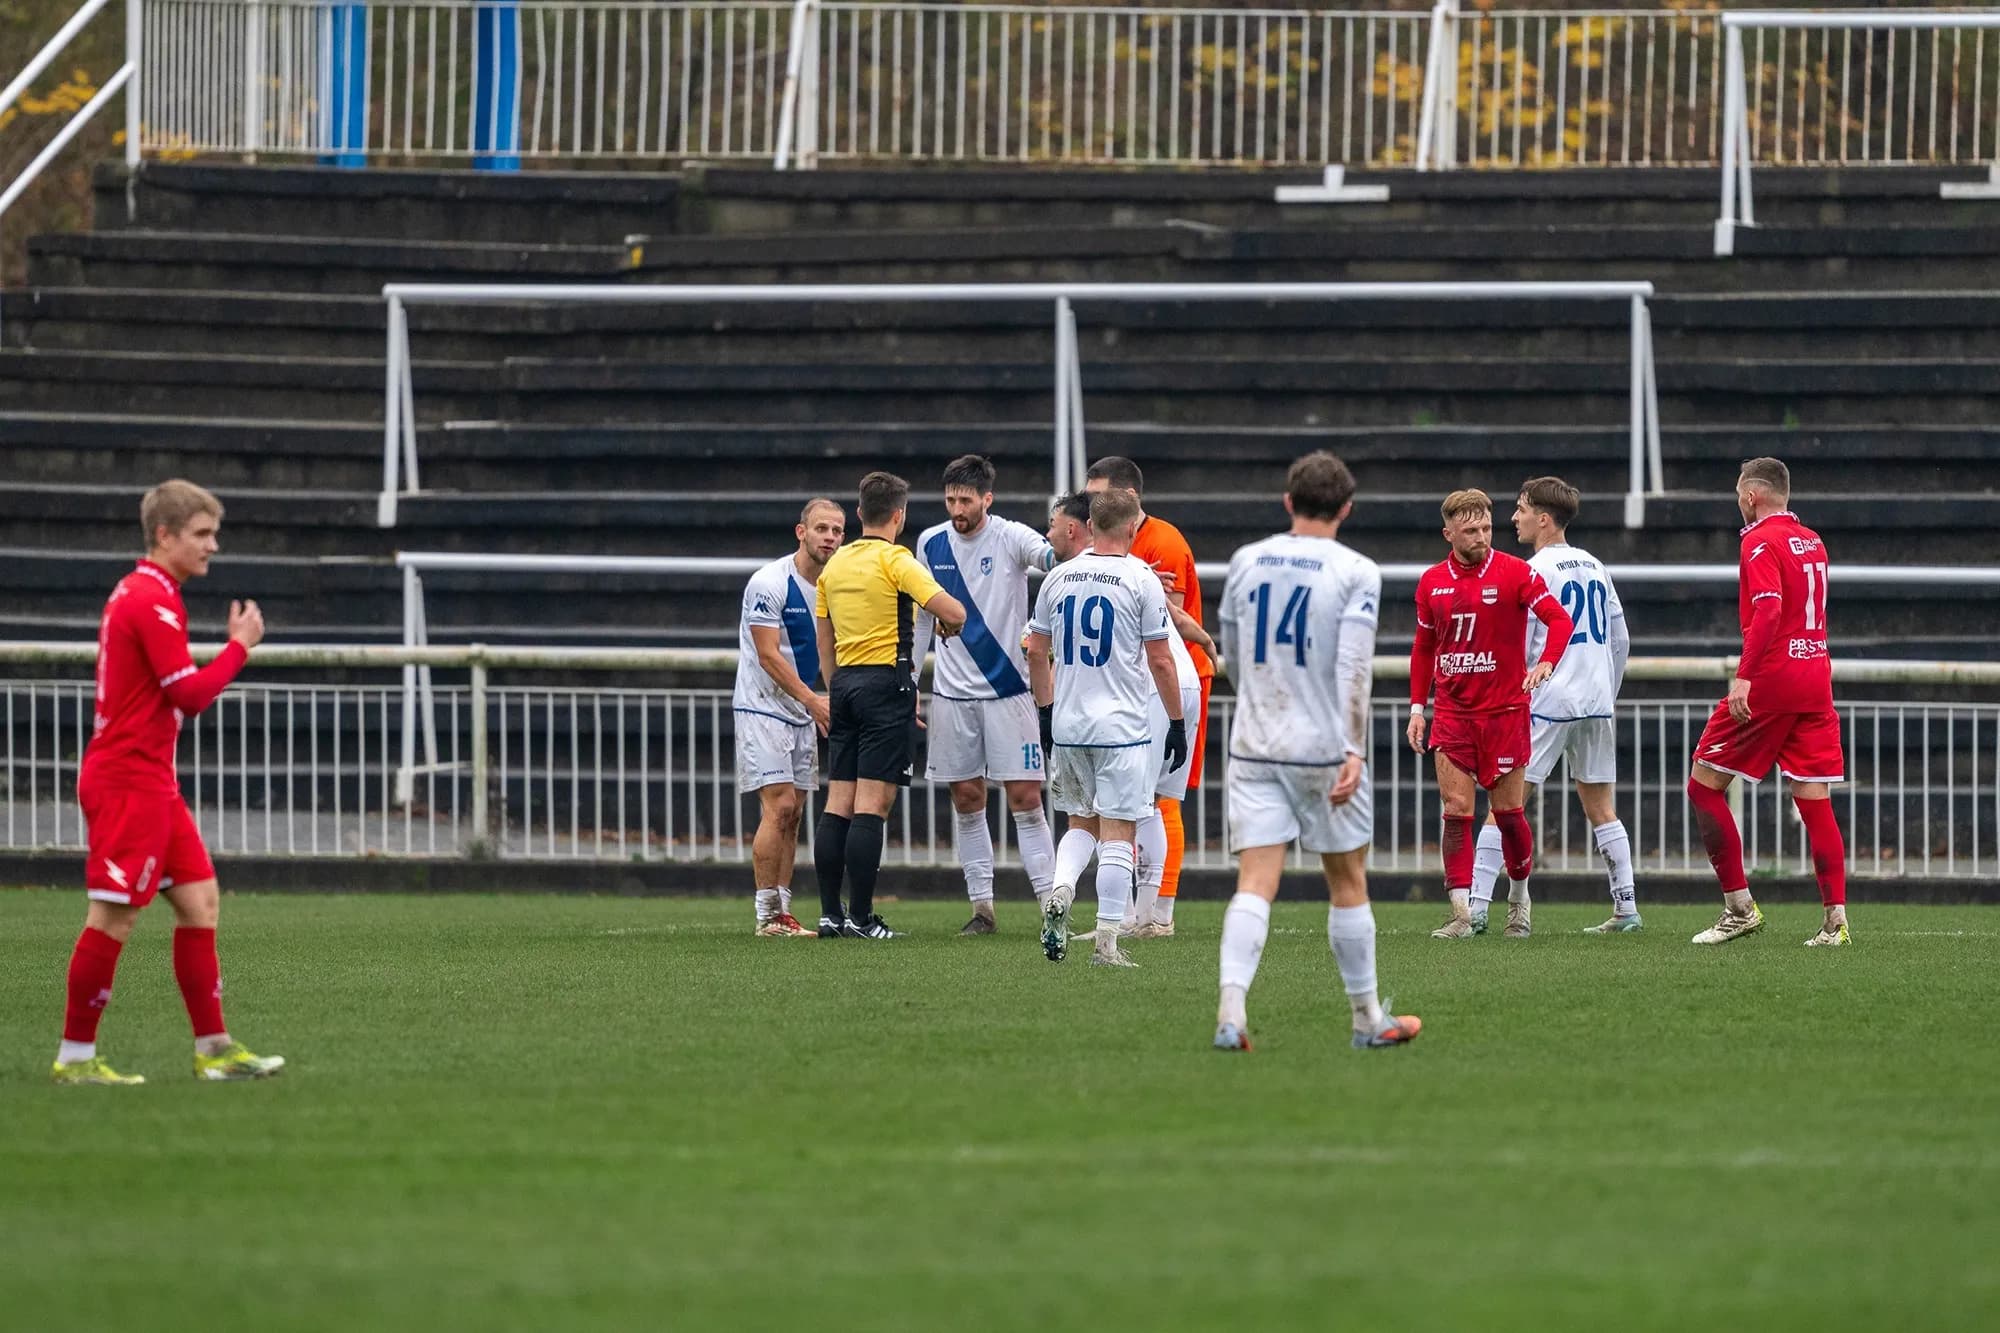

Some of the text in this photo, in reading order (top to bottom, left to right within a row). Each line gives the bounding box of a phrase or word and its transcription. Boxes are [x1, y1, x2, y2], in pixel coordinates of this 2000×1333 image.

[1431, 587, 1455, 596] Zeus
[1561, 580, 1606, 645] 20
[1803, 562, 1827, 630] 11
[1057, 595, 1115, 667] 19
[1249, 583, 1312, 667] 14
[1451, 613, 1476, 642] 77
[1450, 665, 1496, 674] START BRNO
[1022, 744, 1041, 769] 15
